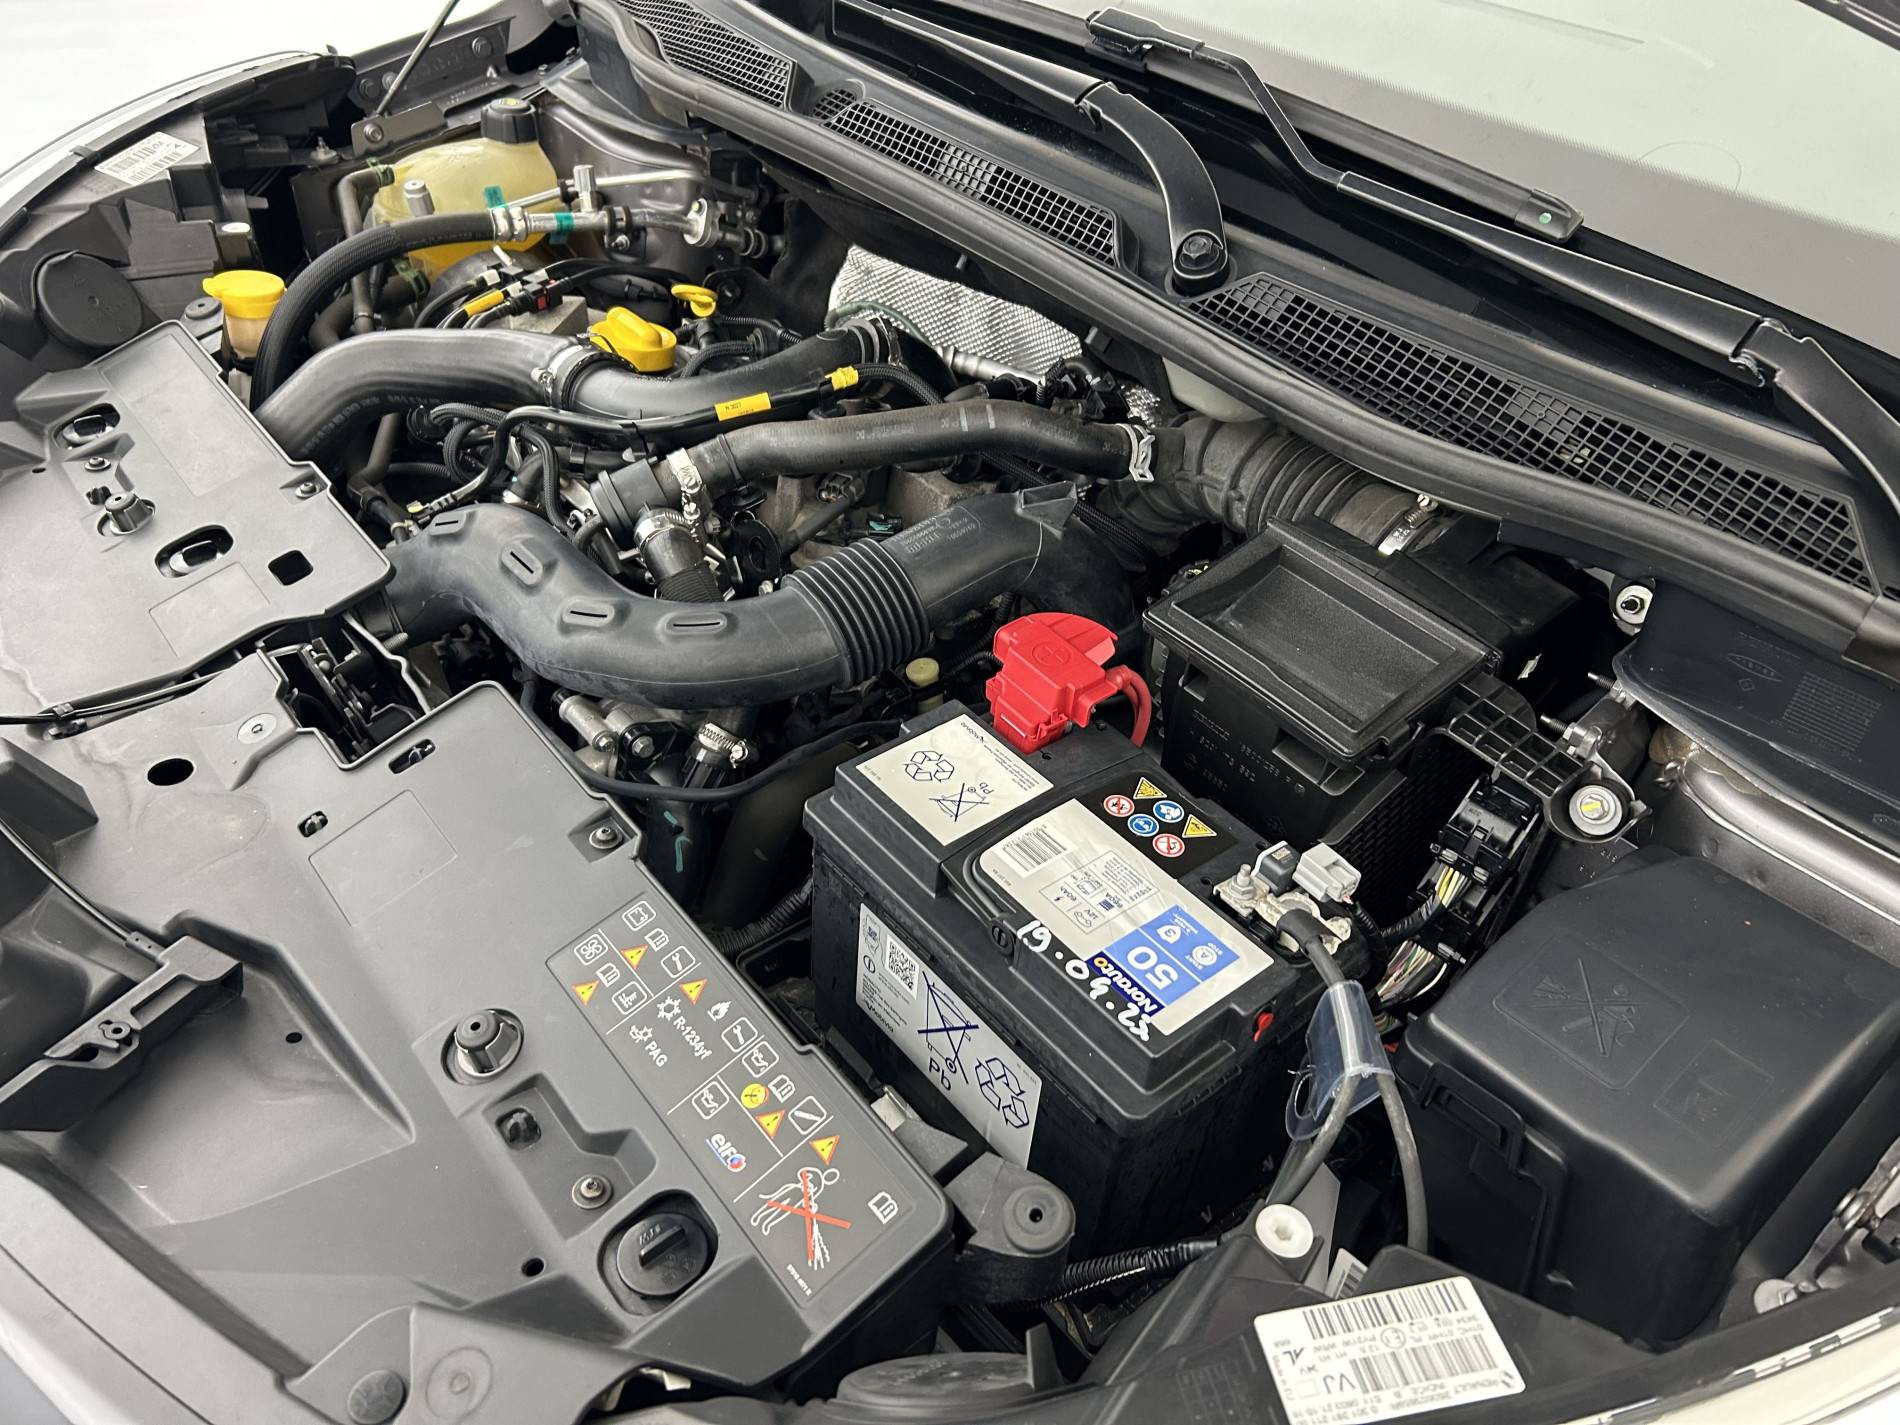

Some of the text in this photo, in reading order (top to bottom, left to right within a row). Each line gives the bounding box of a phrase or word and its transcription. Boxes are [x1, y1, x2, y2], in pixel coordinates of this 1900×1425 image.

[979, 782, 995, 795] Pb
[1124, 946, 1178, 990] 50
[1093, 956, 1158, 1013] Norauto
[645, 1041, 668, 1067] PAG
[928, 1057, 951, 1091] Pb
[711, 1133, 738, 1161] elf
